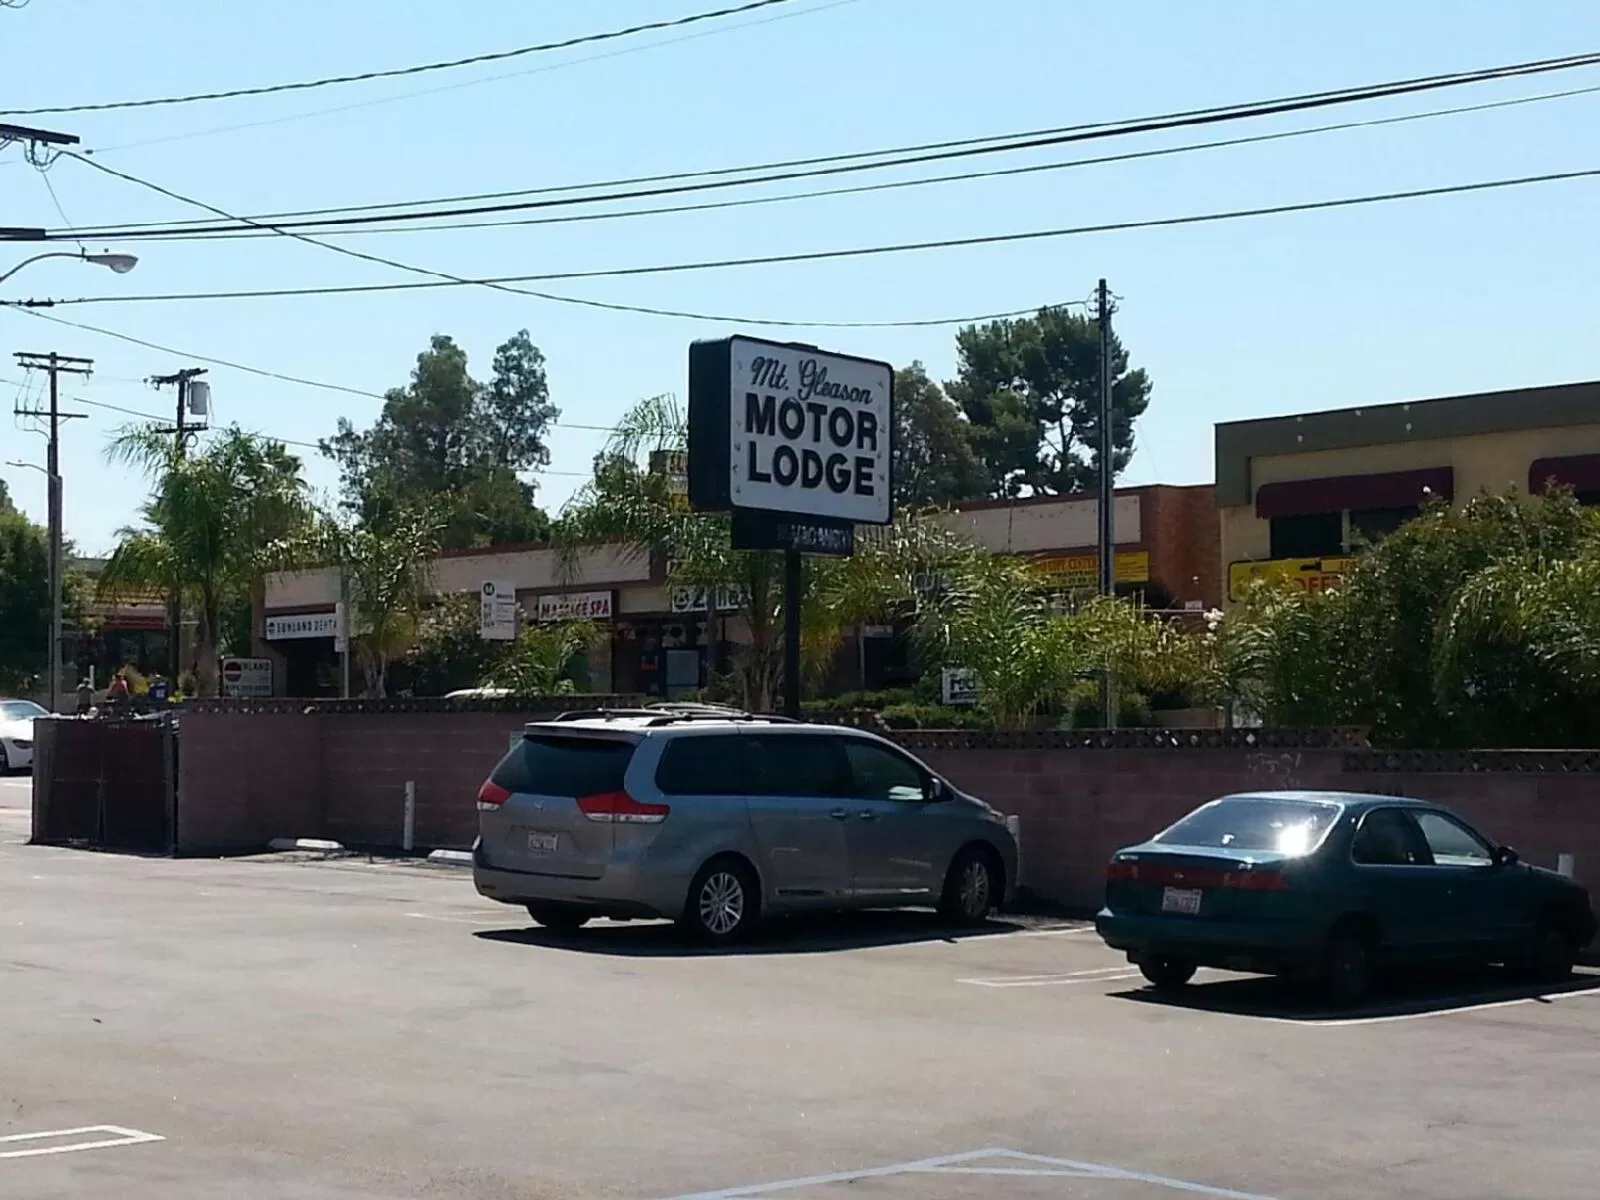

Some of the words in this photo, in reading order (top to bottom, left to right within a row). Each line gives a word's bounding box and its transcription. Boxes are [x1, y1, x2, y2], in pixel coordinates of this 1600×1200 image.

[751, 356, 789, 391] Mt.
[798, 359, 873, 405] Gleason
[745, 392, 877, 451] MOTOR
[748, 441, 874, 496] LODGE
[590, 599, 609, 616] SPA
